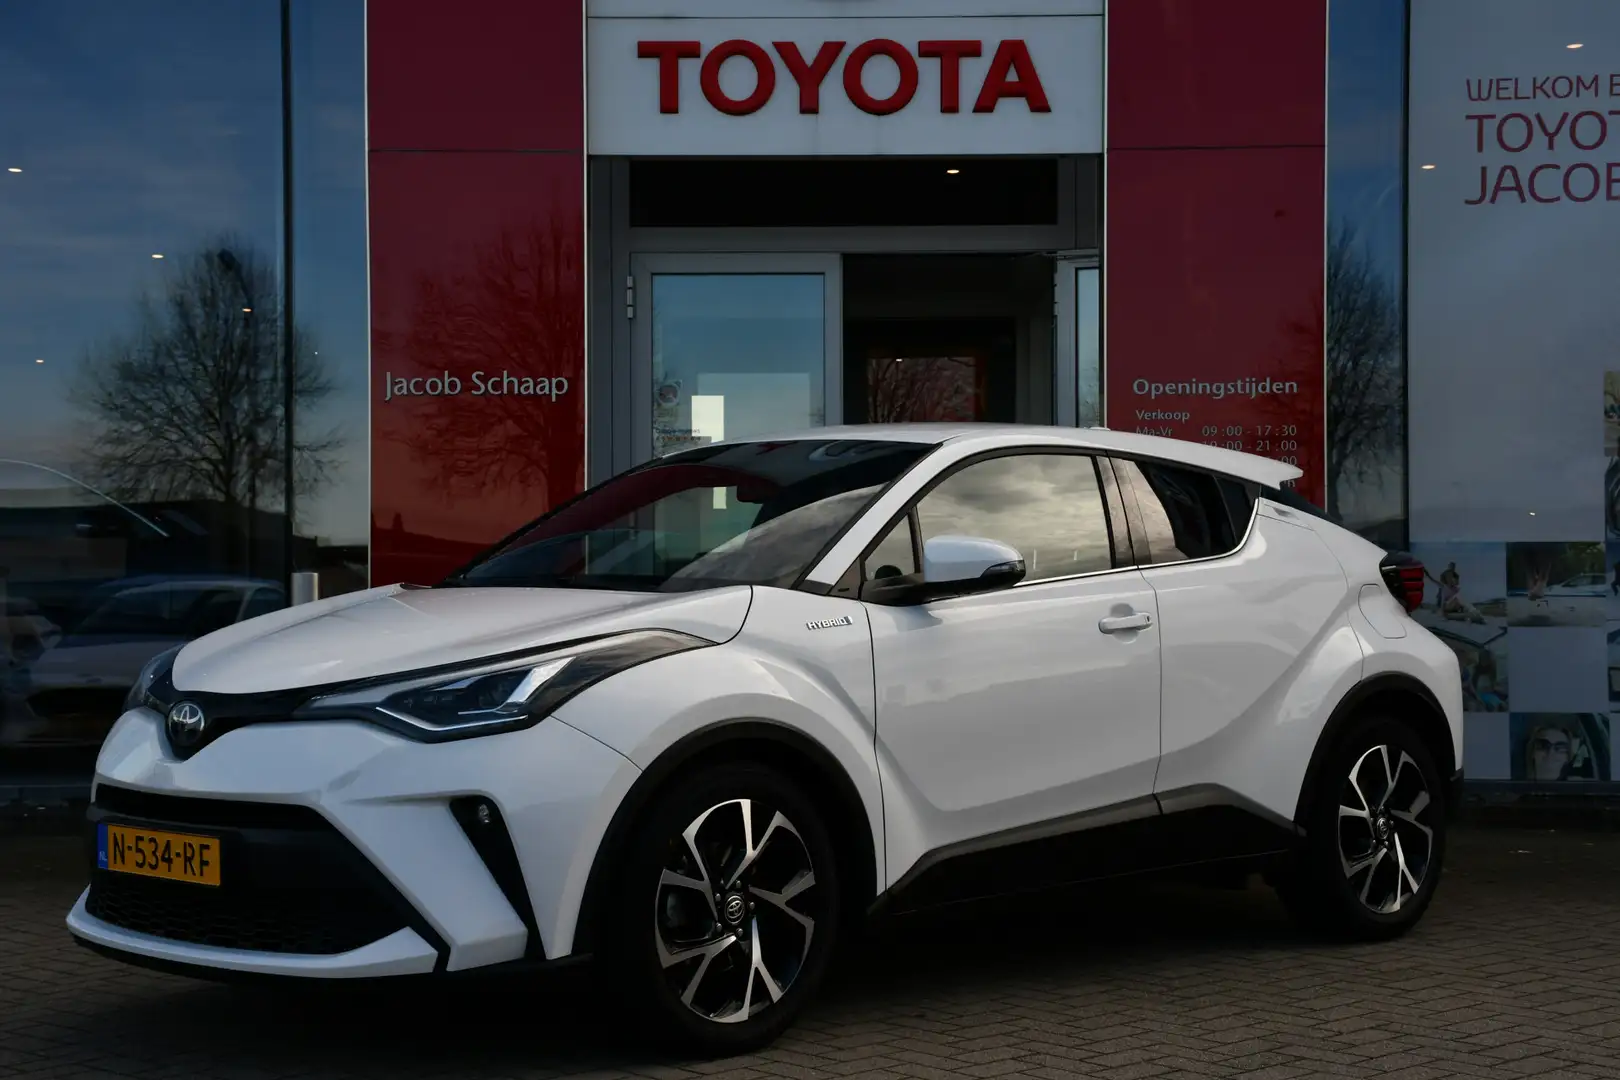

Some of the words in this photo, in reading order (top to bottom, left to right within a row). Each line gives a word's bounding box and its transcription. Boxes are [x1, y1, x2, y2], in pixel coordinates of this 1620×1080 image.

[637, 39, 1051, 116] TOYOTA
[1466, 75, 1599, 102] WELKOM
[384, 370, 462, 401] Jacob
[471, 370, 569, 404] Schaap
[1132, 377, 1298, 400] Openingstijden
[1135, 409, 1190, 423] Verkoop
[1135, 426, 1173, 436] Ma-Vr
[806, 616, 851, 630] HYBRID
[112, 832, 210, 877] N-534-RF
